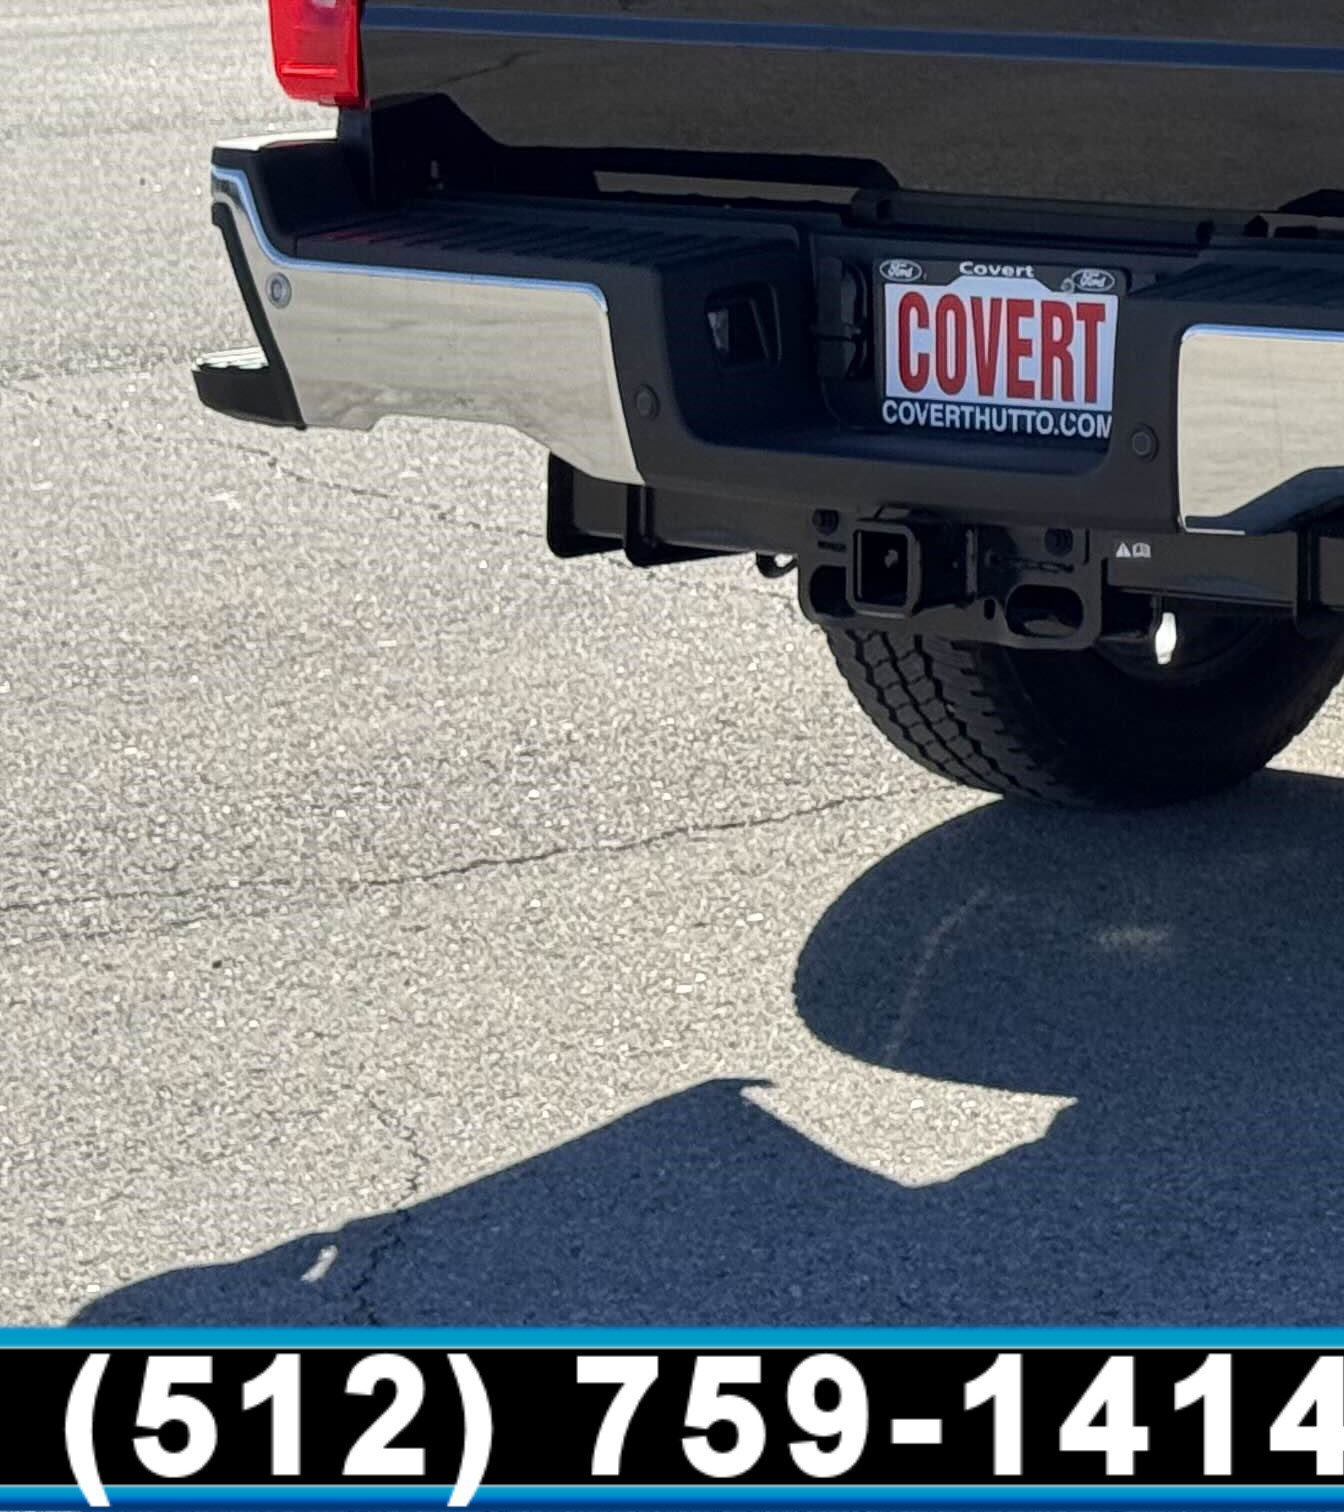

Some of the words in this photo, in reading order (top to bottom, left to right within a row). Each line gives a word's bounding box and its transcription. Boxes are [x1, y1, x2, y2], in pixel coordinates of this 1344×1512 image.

[887, 261, 914, 278] Ford
[959, 261, 1035, 278] Covert
[1079, 270, 1107, 288] Ford
[898, 291, 1106, 404] COVERT
[882, 399, 1112, 438] COVERTHUTTO.COM
